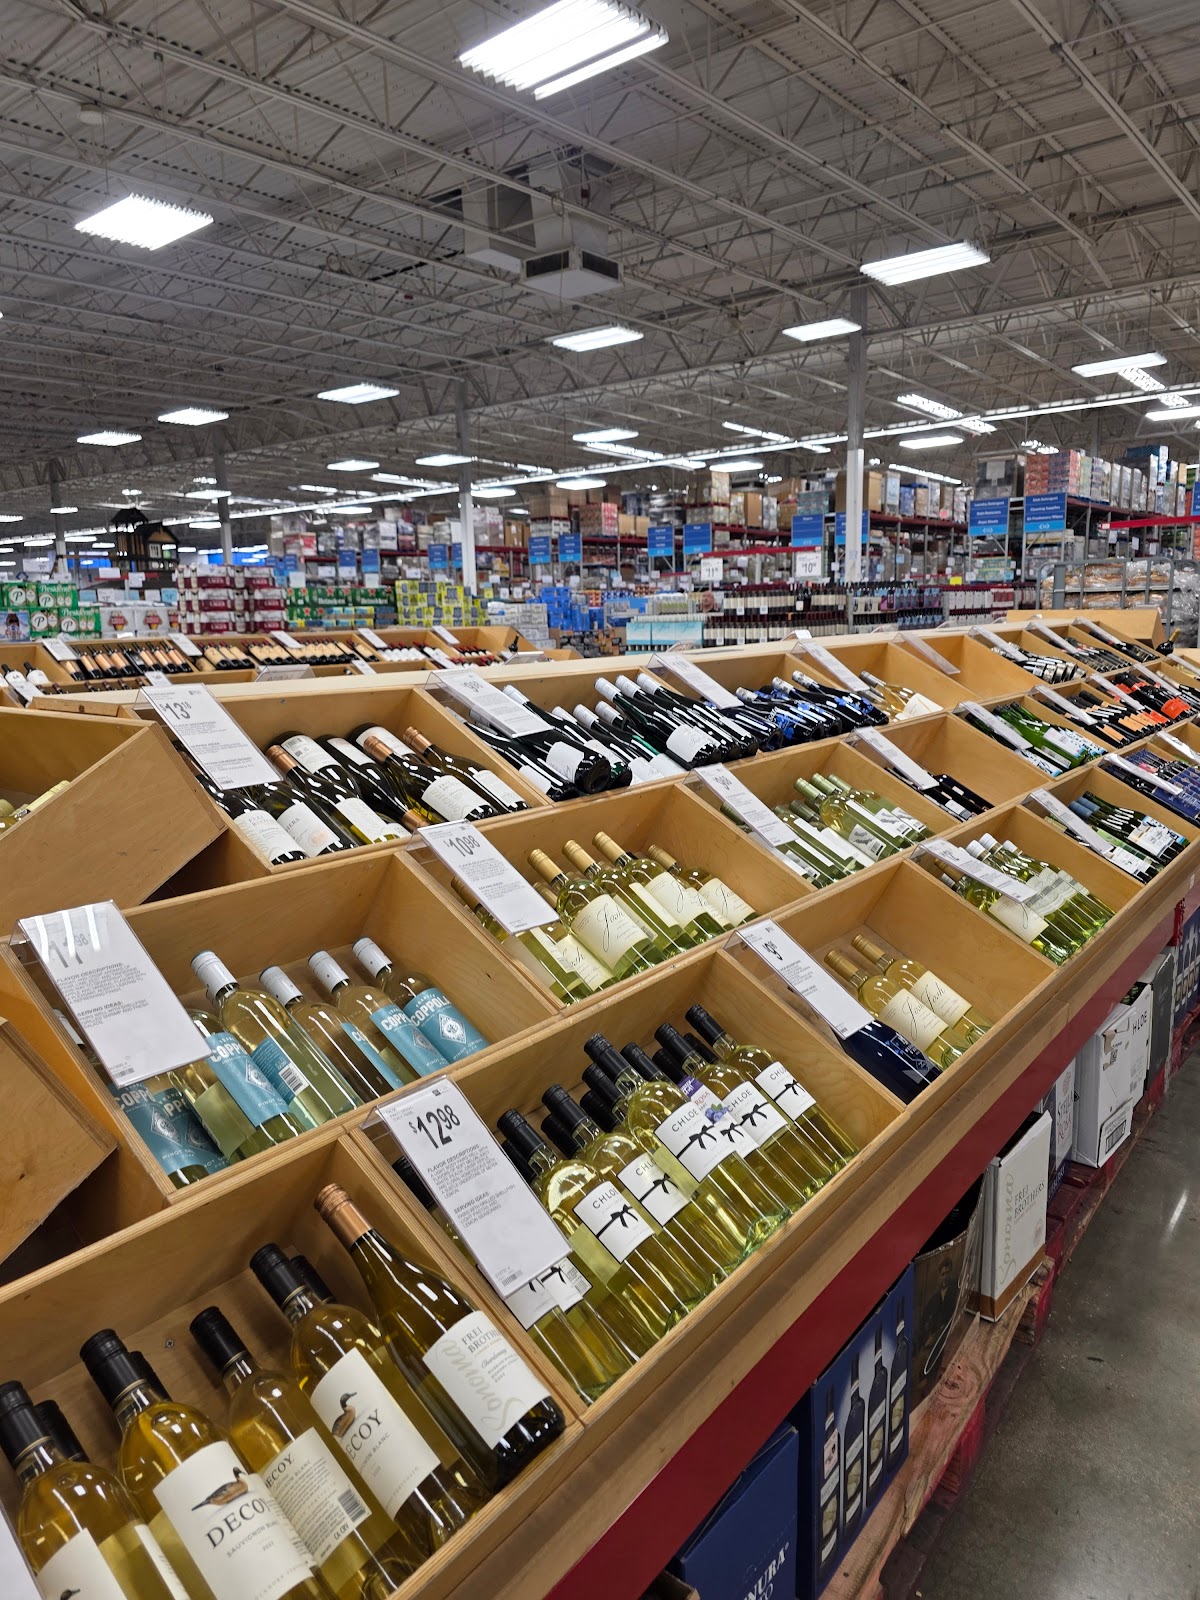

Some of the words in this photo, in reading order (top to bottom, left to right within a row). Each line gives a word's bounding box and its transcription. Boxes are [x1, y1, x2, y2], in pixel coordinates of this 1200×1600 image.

[55, 974, 80, 983] FLAVOR
[76, 1006, 103, 1017] SERVING
[727, 1089, 752, 1112] CHLOE
[409, 1104, 461, 1149] $1298
[672, 1109, 699, 1132] CHLOE
[426, 1160, 447, 1173] FLAVOR
[453, 1198, 475, 1214] SERVING
[462, 1326, 483, 1345] FREI
[227, 1523, 265, 1558] SAUVIGNON
